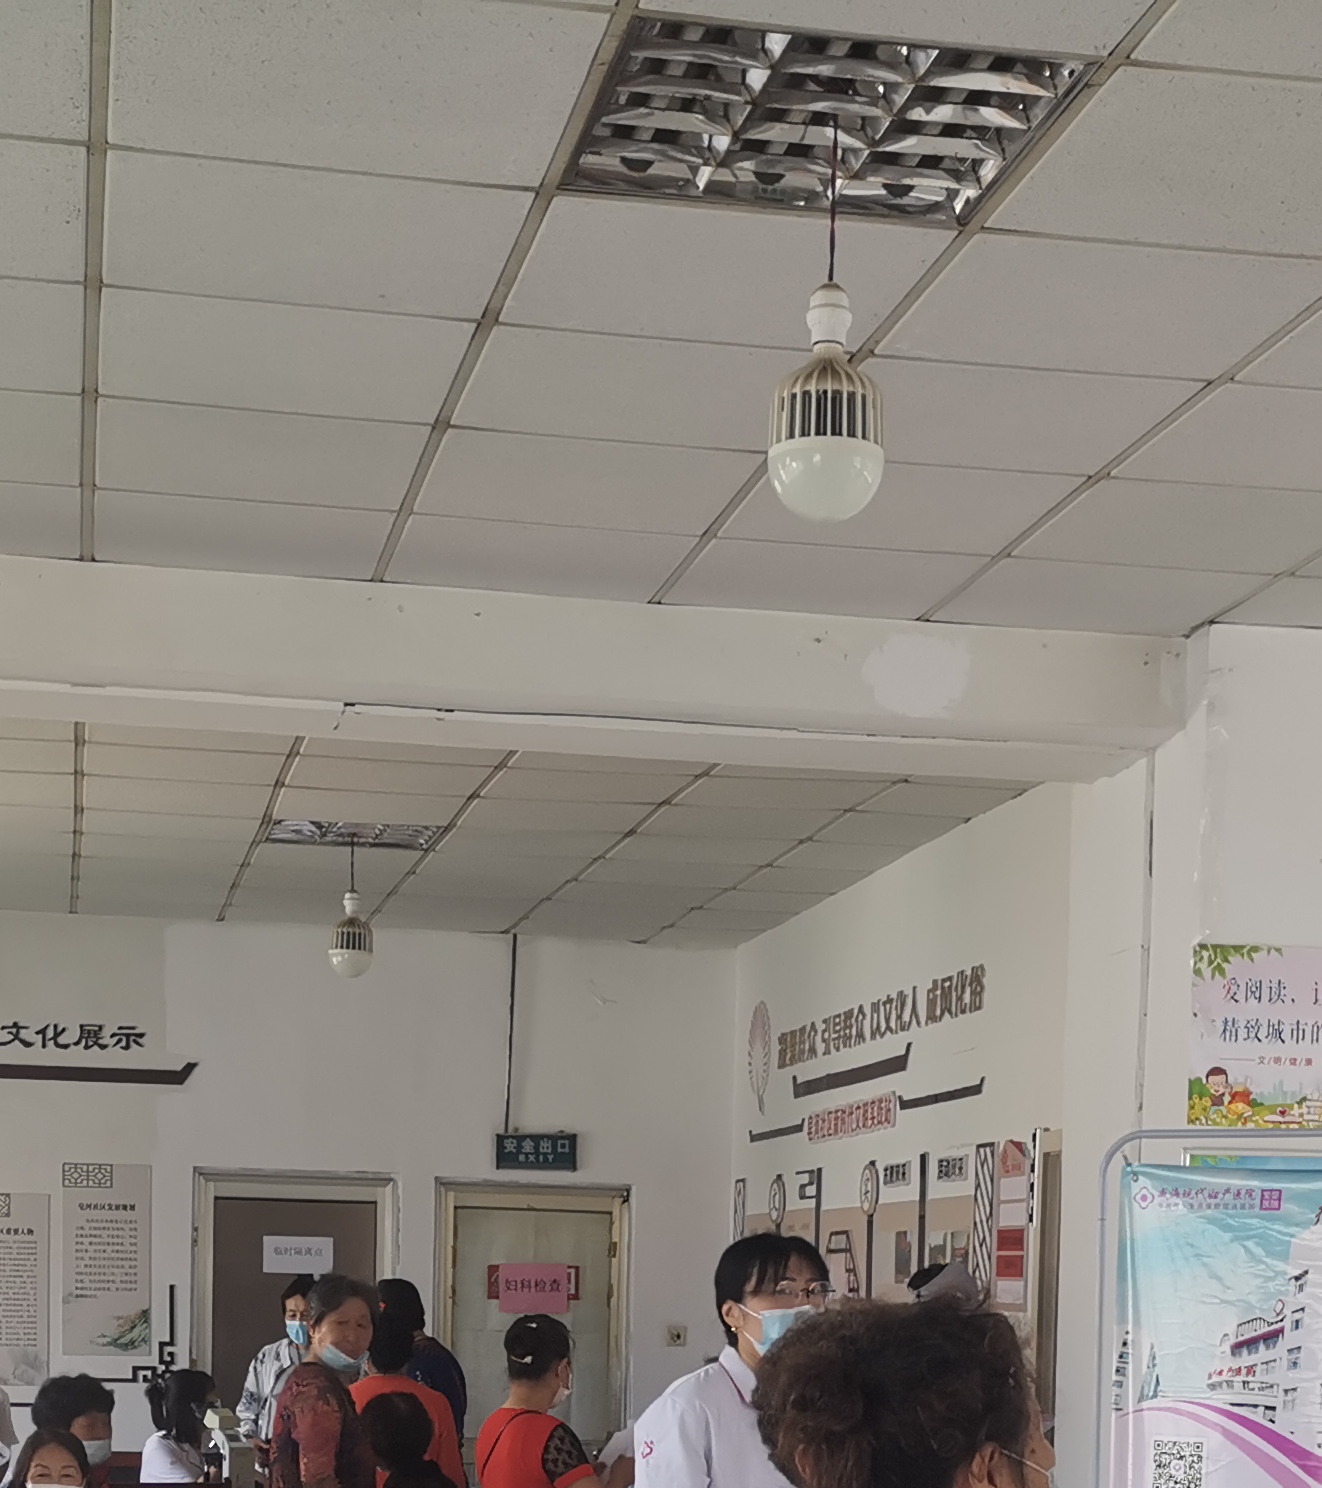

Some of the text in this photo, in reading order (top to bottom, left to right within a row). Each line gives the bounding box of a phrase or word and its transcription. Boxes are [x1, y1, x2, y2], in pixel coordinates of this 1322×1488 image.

[503, 1138, 570, 1153] 安全出口
[519, 1153, 555, 1163] EXIT
[504, 1277, 562, 1294] 妇科检查
